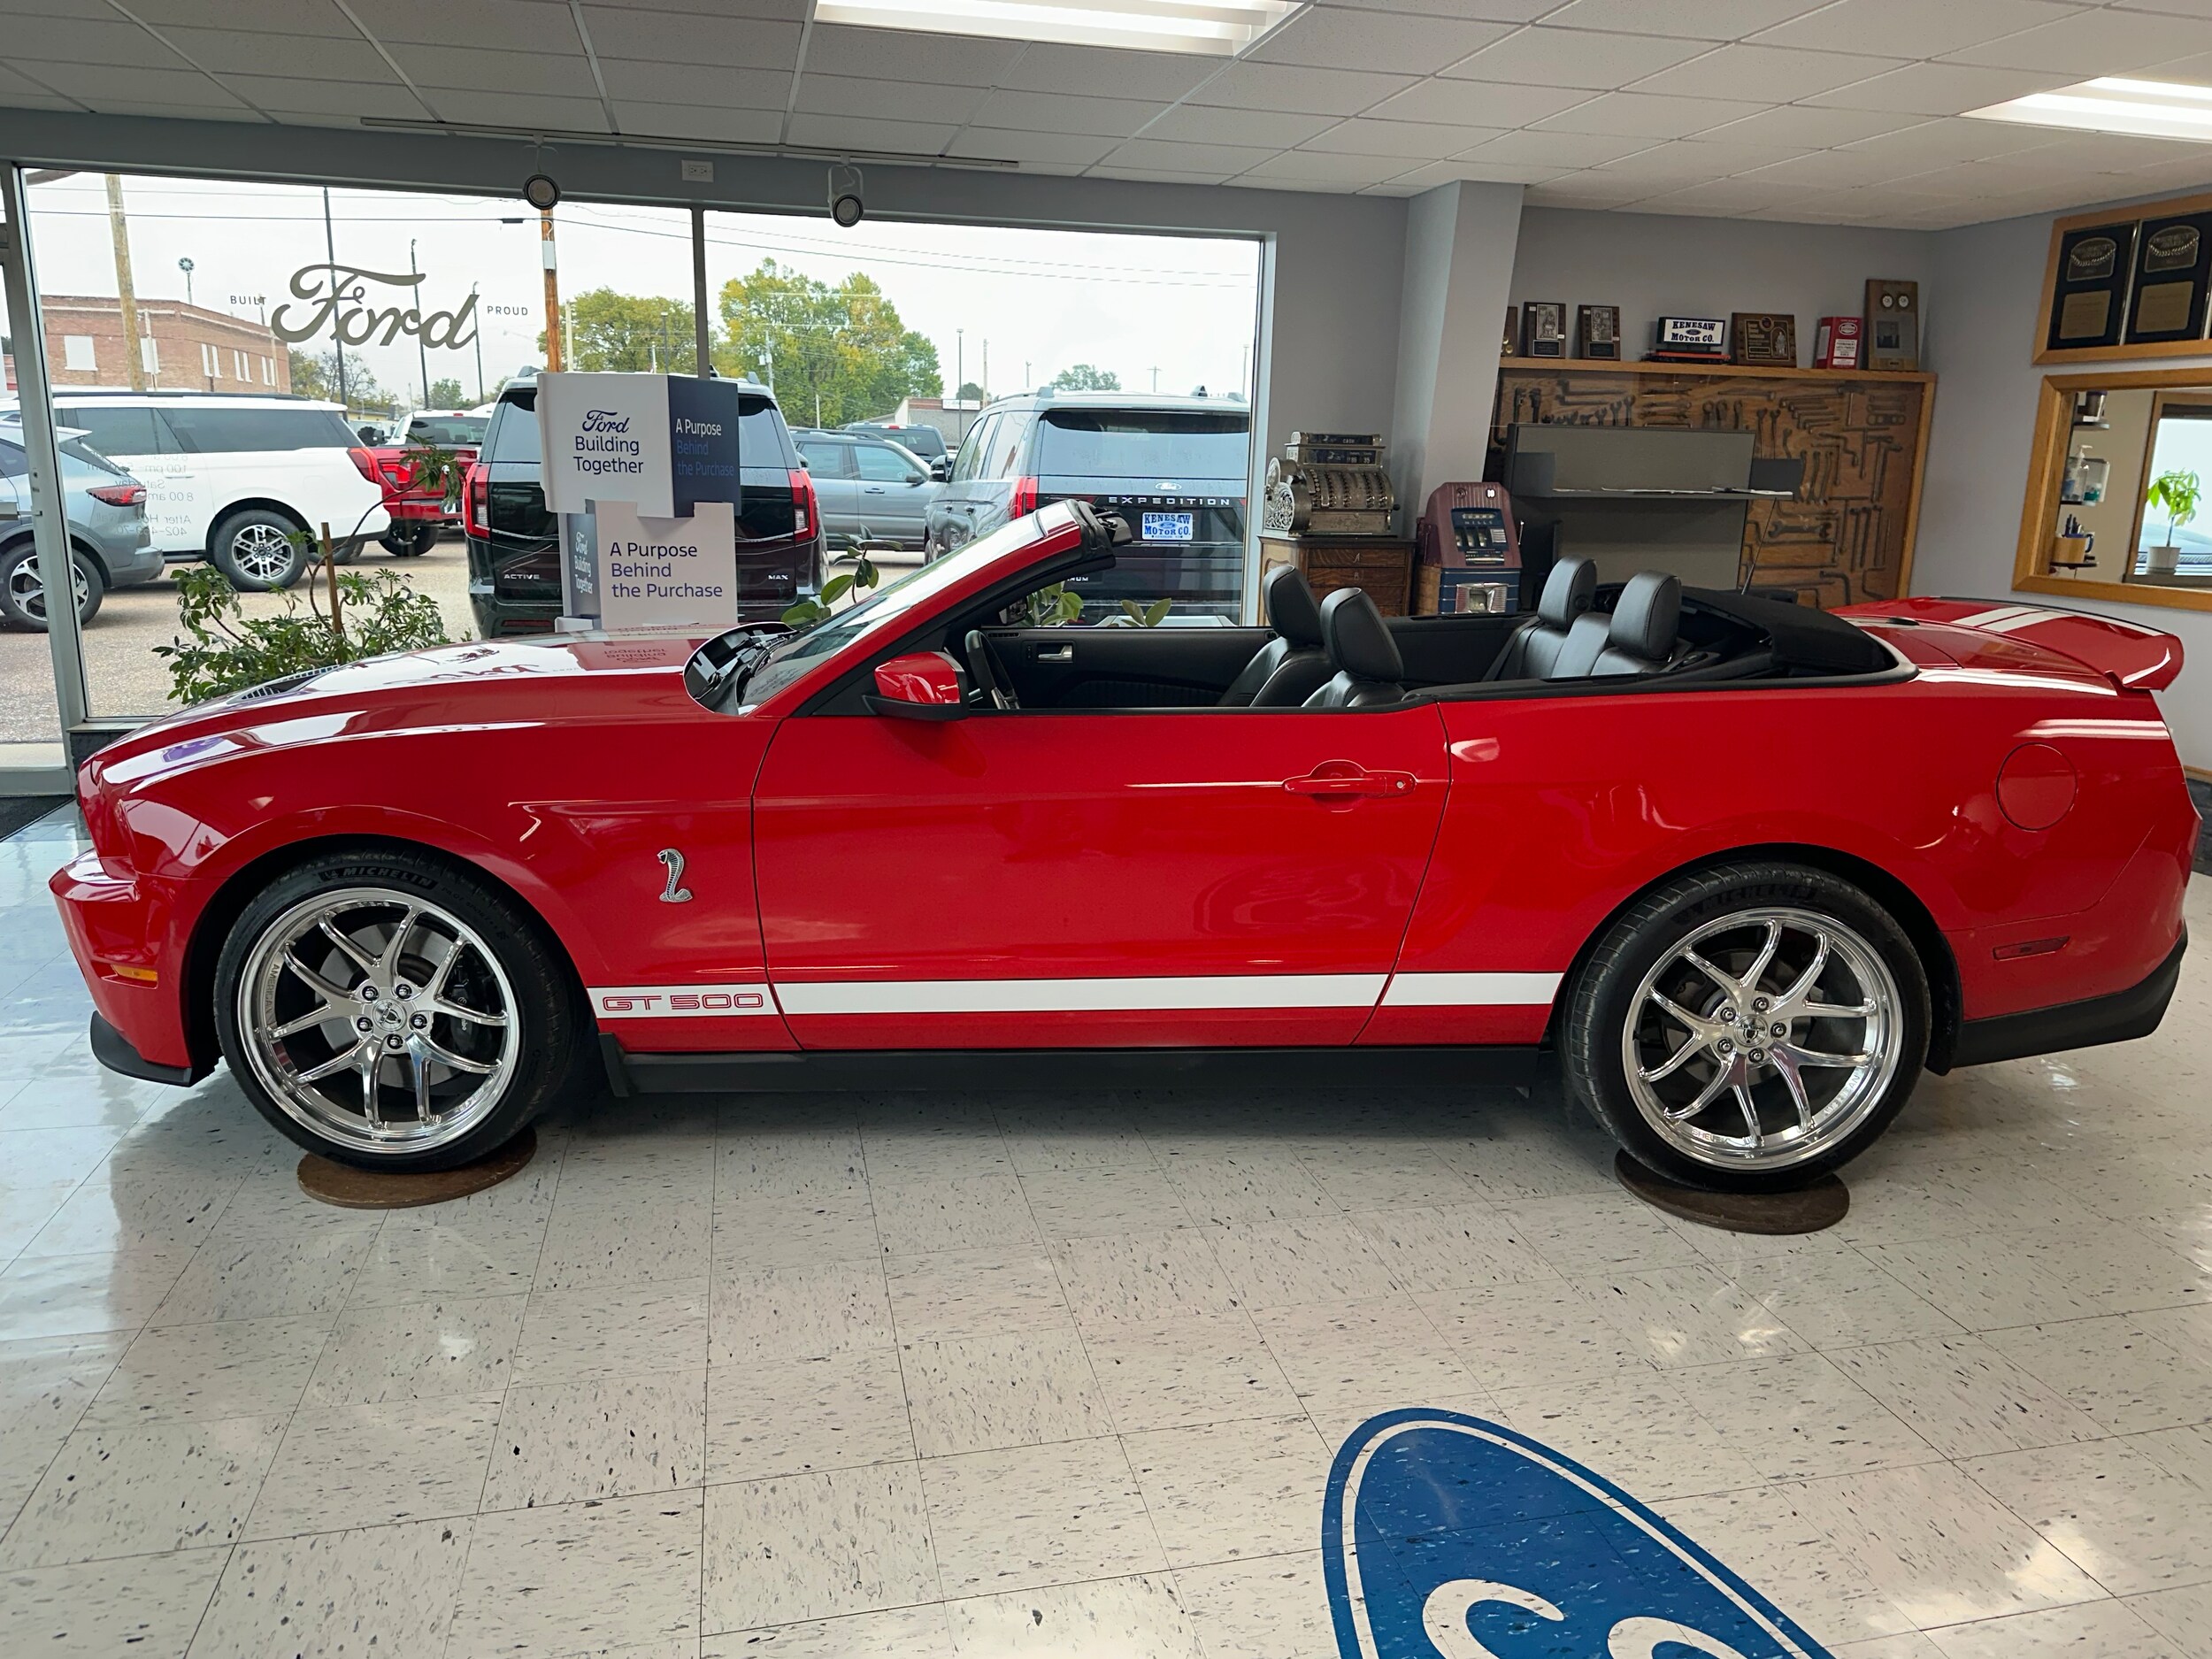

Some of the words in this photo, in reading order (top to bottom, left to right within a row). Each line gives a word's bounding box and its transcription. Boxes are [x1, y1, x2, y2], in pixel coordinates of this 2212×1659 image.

[230, 295, 266, 306] BUILT
[271, 264, 480, 350] Ford
[487, 305, 528, 316] PROUD
[1672, 320, 1717, 332] KENESAW
[1671, 333, 1701, 342] MOTOR
[1702, 334, 1715, 342] CO.
[581, 409, 631, 434] Ford
[675, 418, 683, 434] A
[685, 419, 722, 439] Purpose
[574, 436, 640, 457] Building
[676, 441, 709, 456] Behind
[572, 456, 644, 475] Together
[677, 461, 692, 476] the
[695, 461, 734, 477] Purchase
[1108, 496, 1230, 506] EXPEDITION
[1144, 513, 1191, 525] KENESAW
[1144, 525, 1177, 535] MOTOR
[1178, 526, 1191, 535] CO.
[610, 541, 622, 557] A
[627, 541, 698, 560] Purpose
[611, 563, 672, 578] Behind
[611, 583, 641, 598] the
[646, 583, 724, 598] Purchase
[342, 866, 435, 887] MICHELIN
[602, 995, 663, 1011] GT
[669, 993, 764, 1010] 500
